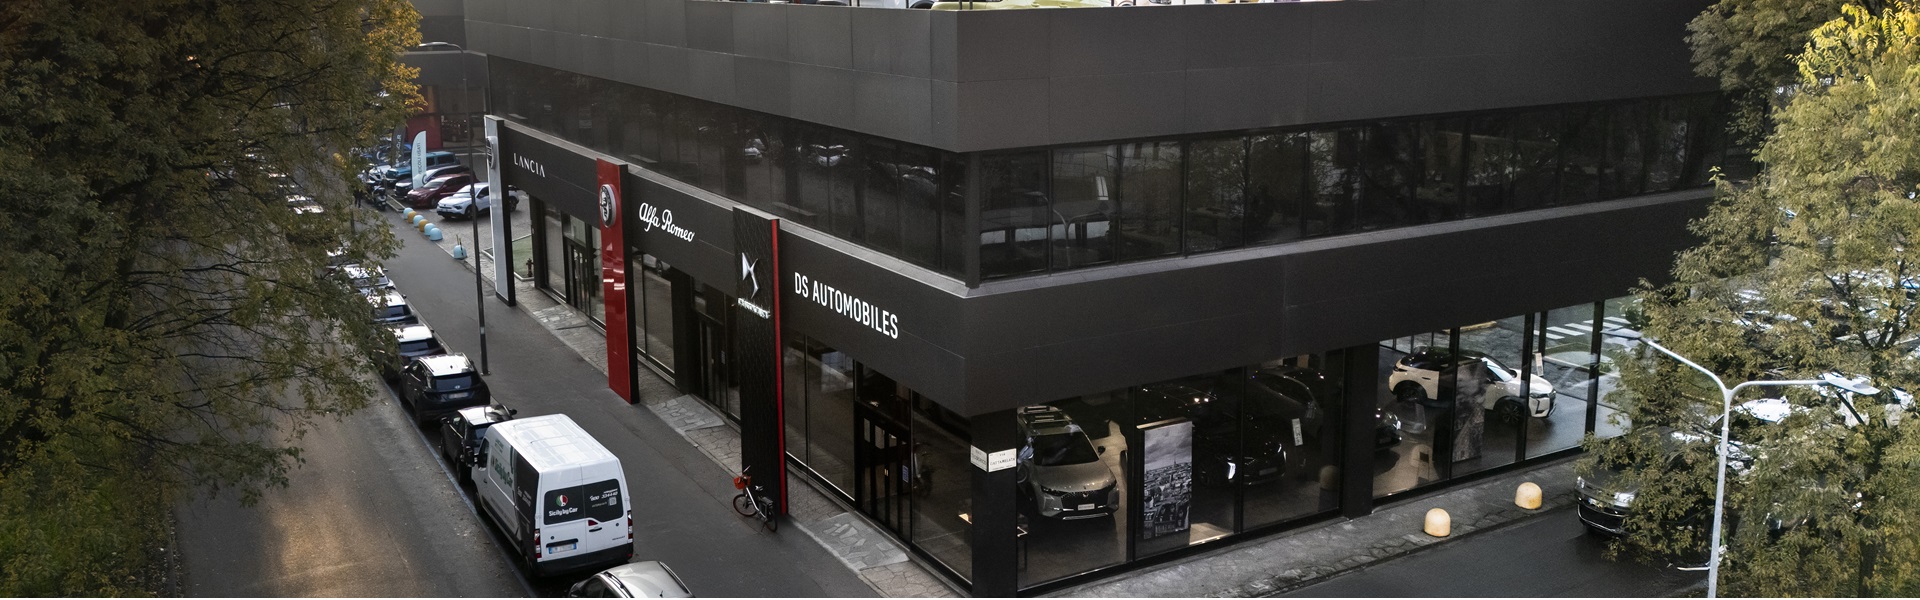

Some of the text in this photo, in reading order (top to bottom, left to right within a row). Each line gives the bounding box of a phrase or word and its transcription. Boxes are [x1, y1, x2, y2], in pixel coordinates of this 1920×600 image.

[513, 152, 545, 178] LANCIA
[639, 202, 695, 242] Alfa Romeo
[794, 271, 809, 298] DS
[812, 280, 898, 339] AUTOMOBILES
